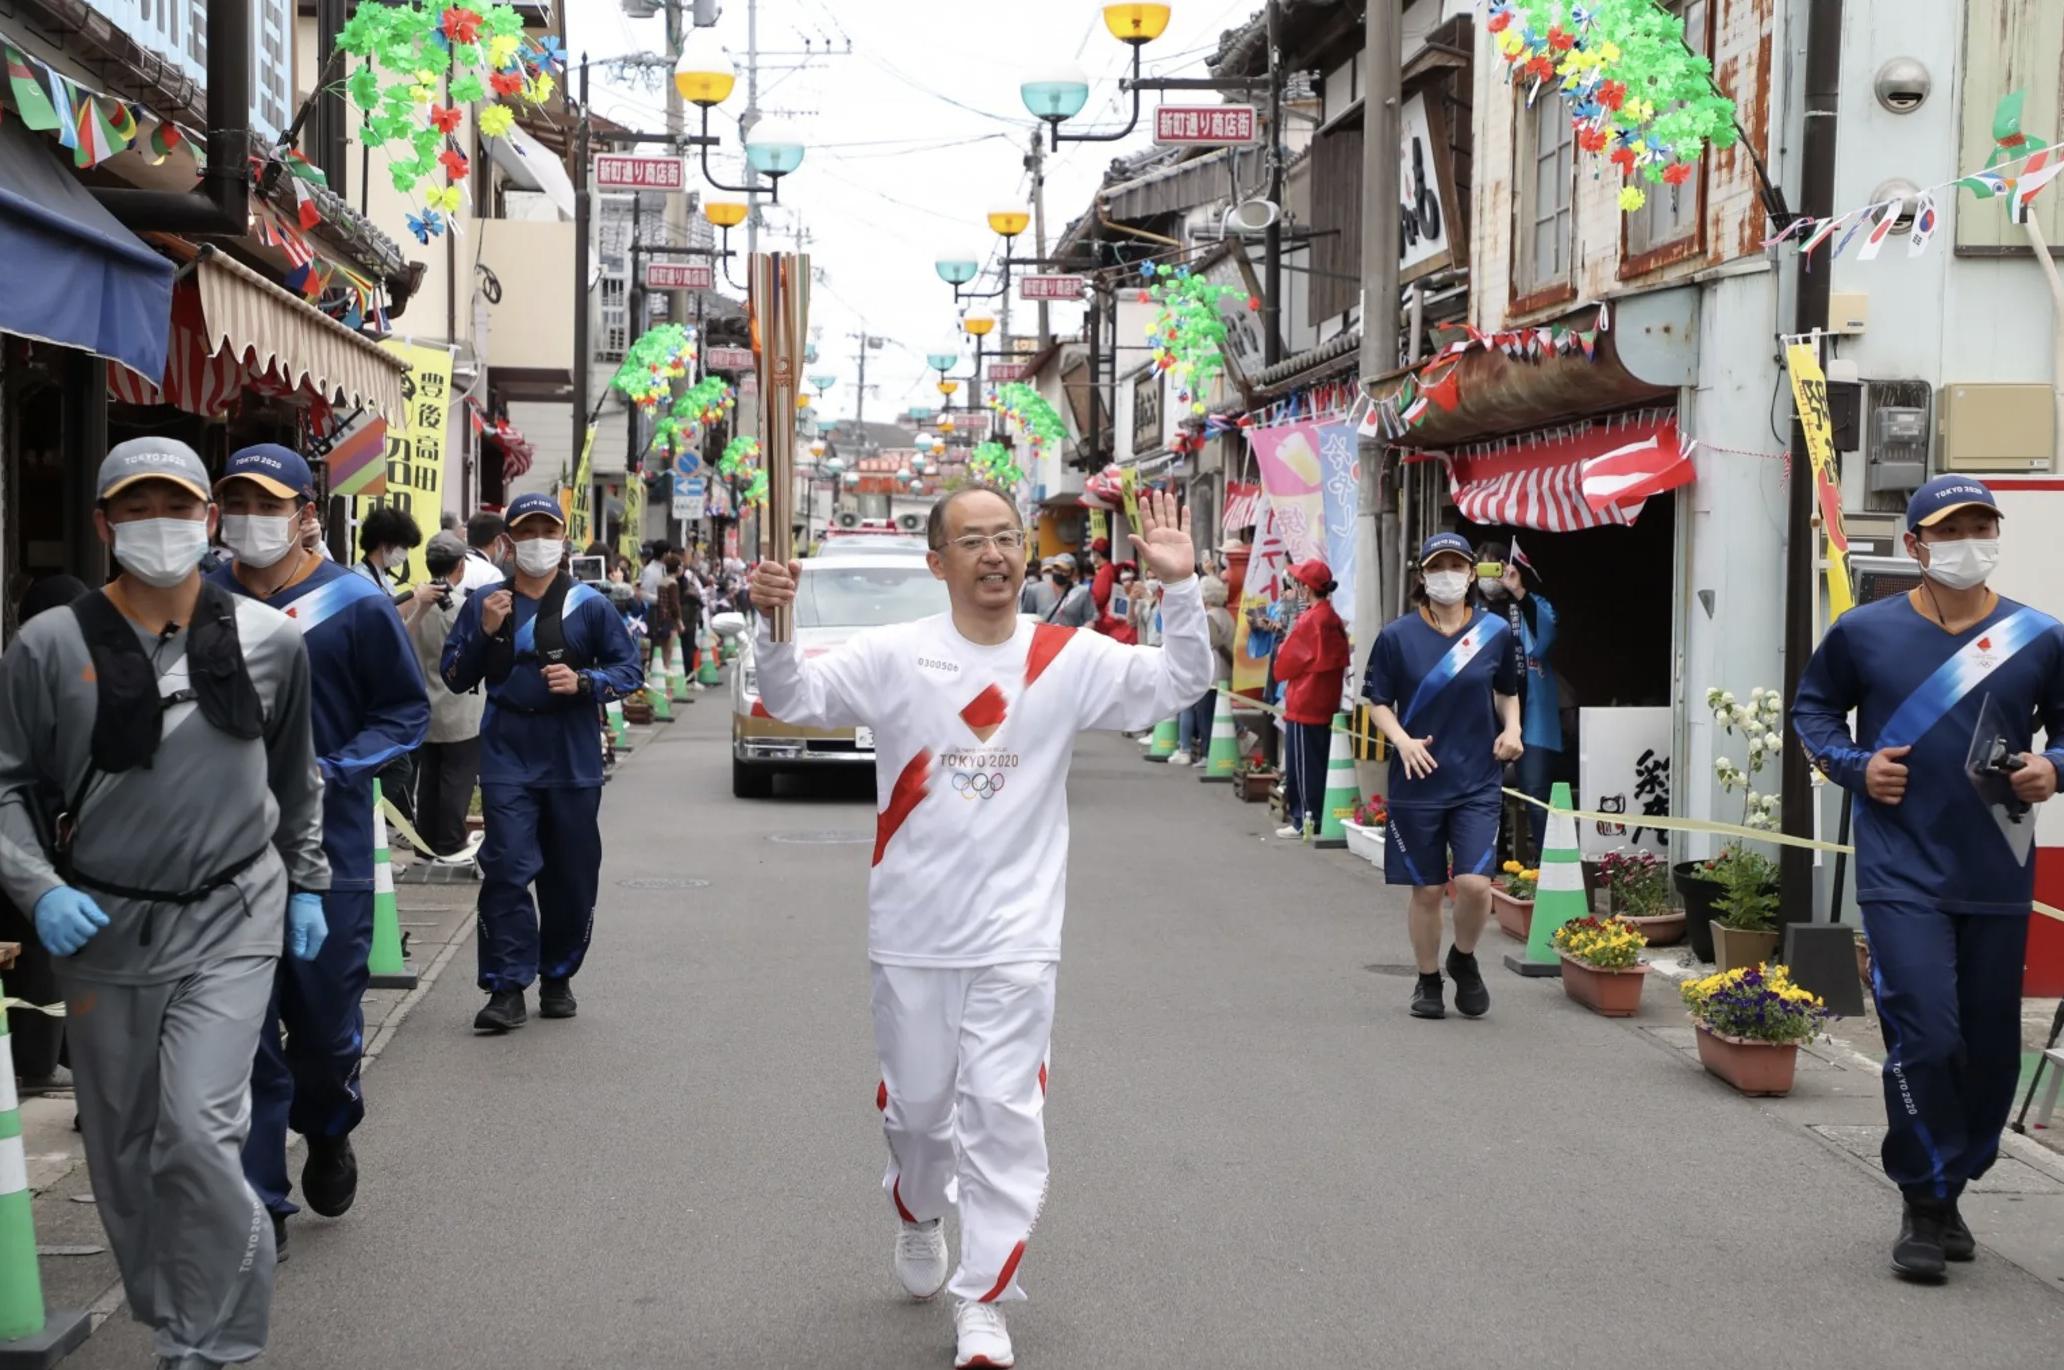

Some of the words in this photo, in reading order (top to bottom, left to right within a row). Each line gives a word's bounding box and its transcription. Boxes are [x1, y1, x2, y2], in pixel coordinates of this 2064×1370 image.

[1160, 111, 1250, 137] 新町通り商店街
[600, 159, 680, 185] 新町通り商店街
[415, 371, 445, 492] 豊後高田
[124, 453, 160, 465] TOKYO
[235, 455, 260, 466] TOKYO
[1934, 486, 1963, 499] TOKYO
[917, 657, 959, 672] 0300506
[940, 753, 985, 768] TOKYO
[989, 753, 1019, 768] 2020
[1901, 1091, 1918, 1115] 2020
[239, 1234, 259, 1272] TOKYO
